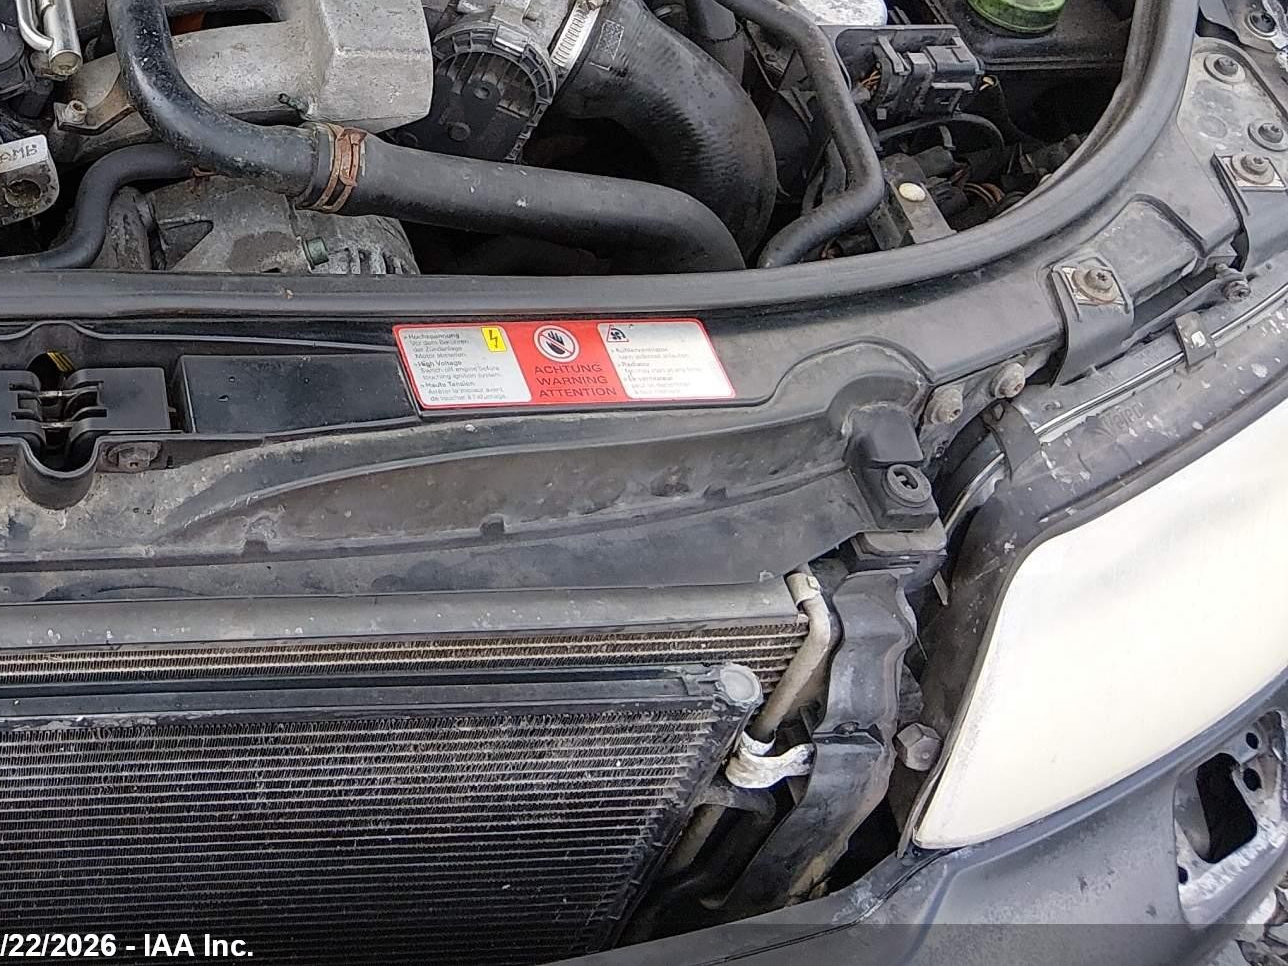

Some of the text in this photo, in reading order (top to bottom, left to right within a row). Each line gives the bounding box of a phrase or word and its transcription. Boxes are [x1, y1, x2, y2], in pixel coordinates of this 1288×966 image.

[534, 363, 602, 375] ACHTUNG
[535, 375, 609, 386] WARNING
[539, 387, 617, 398] ATTENTION
